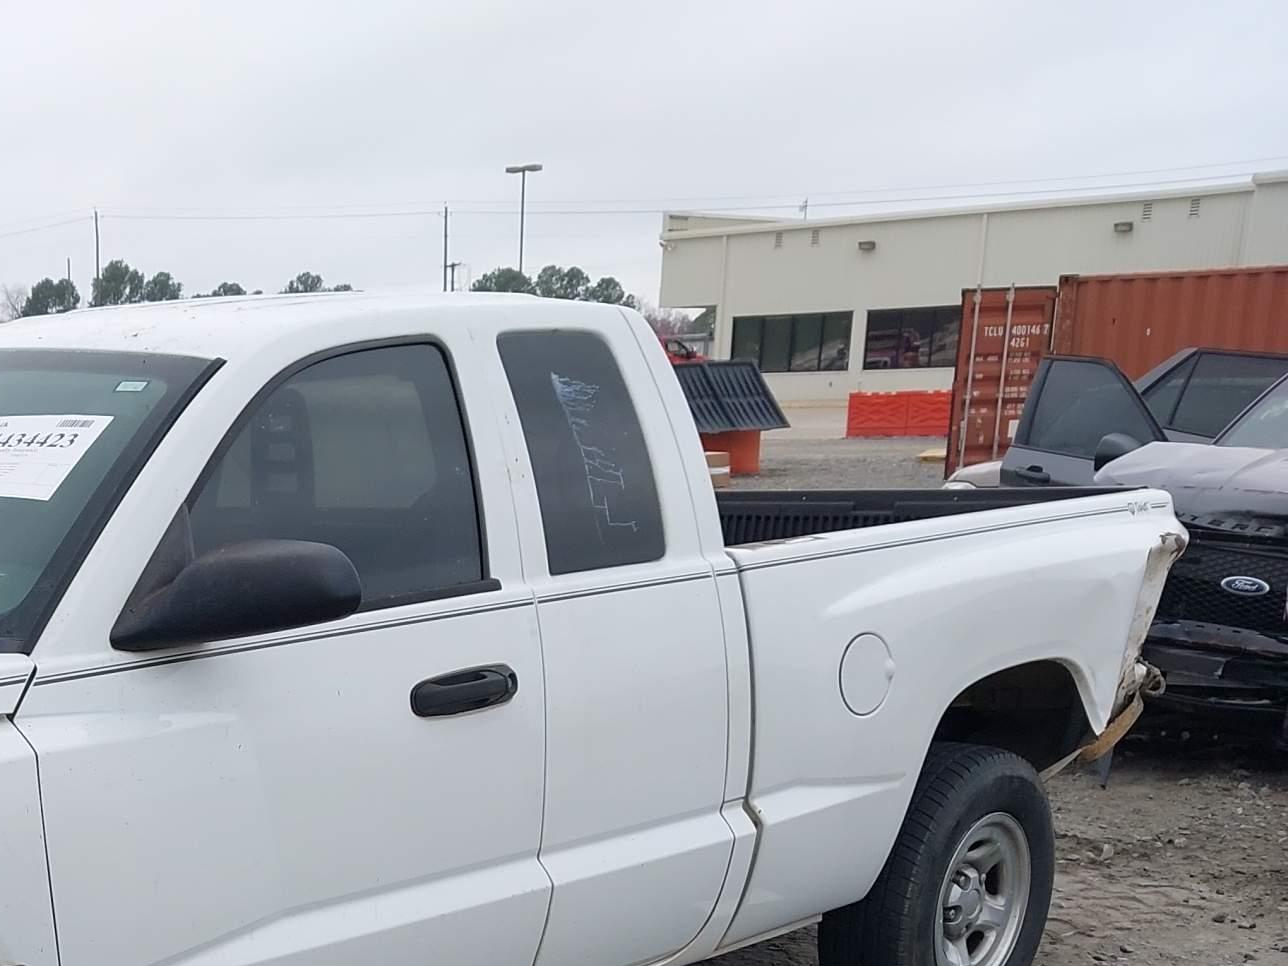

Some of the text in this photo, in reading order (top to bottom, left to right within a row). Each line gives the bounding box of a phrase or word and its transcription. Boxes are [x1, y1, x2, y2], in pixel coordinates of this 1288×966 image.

[984, 325, 1004, 337] TCLU
[1012, 324, 1041, 336] 400146
[1232, 579, 1259, 591] Ford
